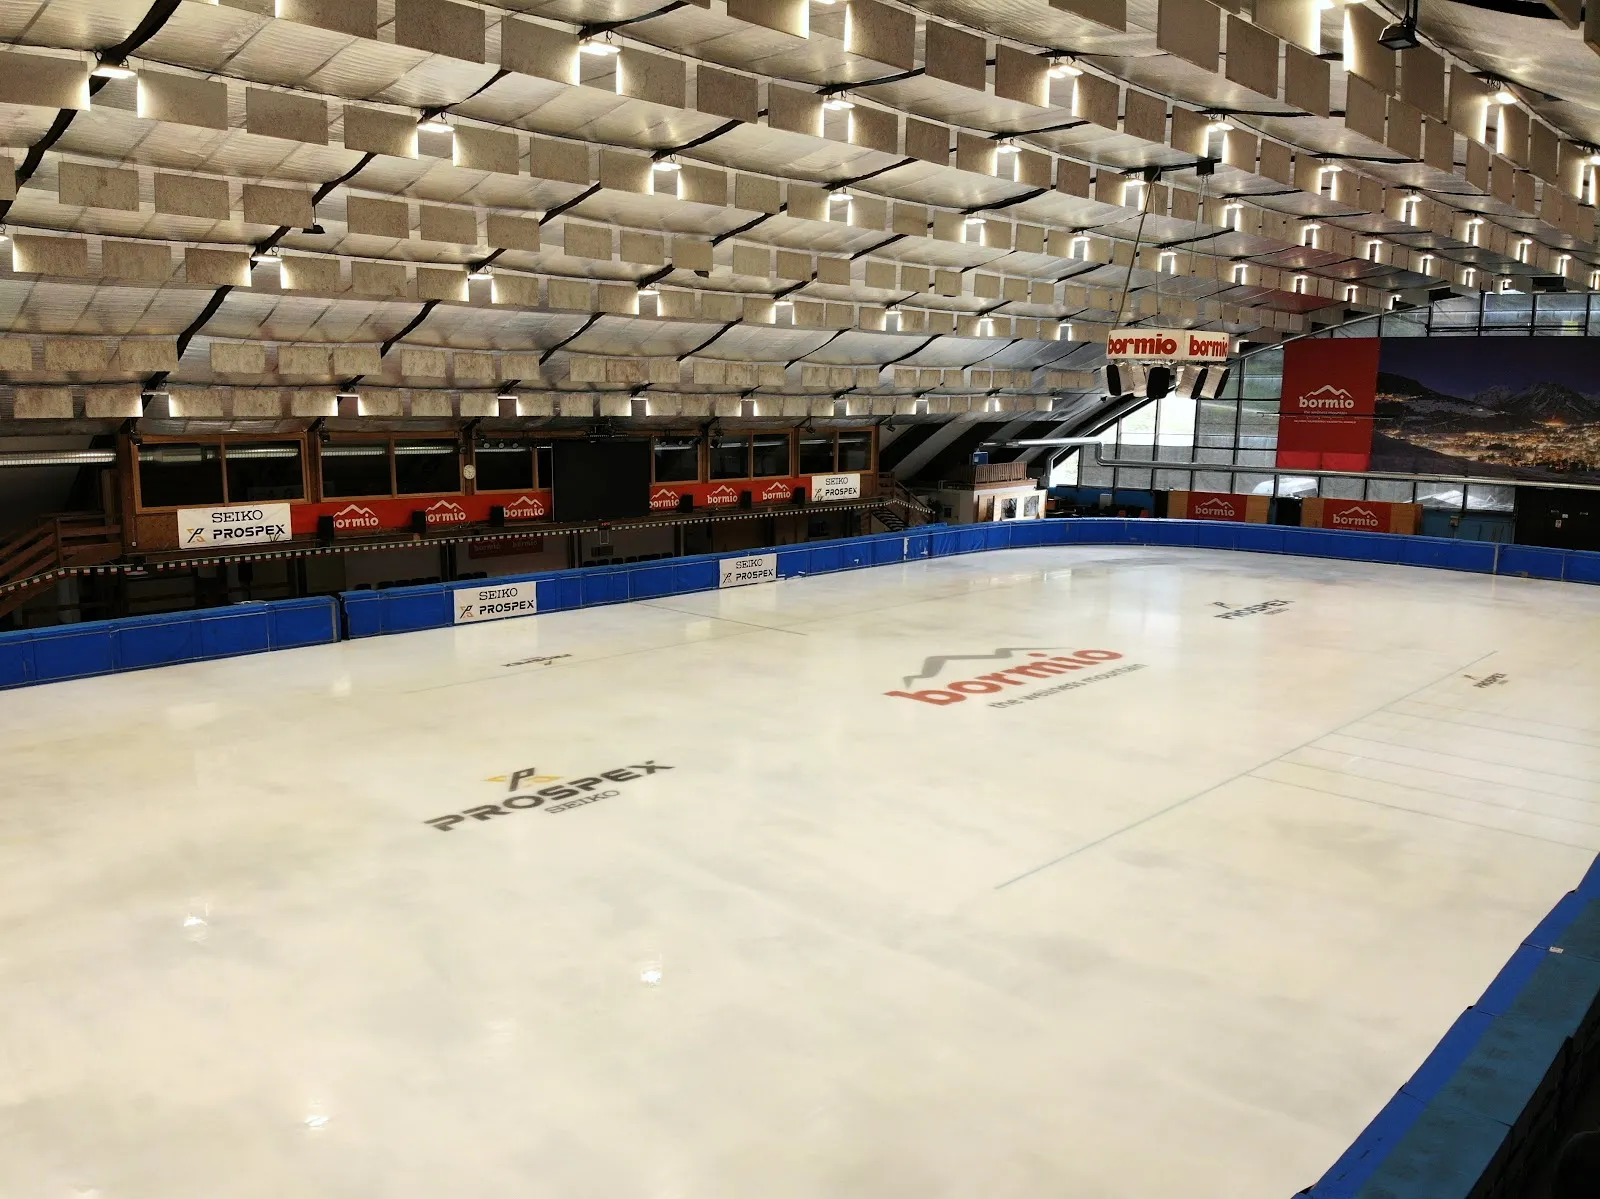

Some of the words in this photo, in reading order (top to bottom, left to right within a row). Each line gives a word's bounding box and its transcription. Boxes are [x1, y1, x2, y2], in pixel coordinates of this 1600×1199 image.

[1108, 334, 1177, 355] bormio
[1299, 395, 1354, 408] bormio
[825, 477, 848, 485] SEIKO
[707, 493, 738, 504] bormio
[762, 490, 791, 500] bormio
[825, 487, 858, 496] PROSPEX
[211, 509, 263, 524] SEIKO
[425, 508, 467, 522] ormio
[503, 504, 544, 518] bormio
[1195, 505, 1235, 517] bormio
[333, 513, 379, 528] ormio
[1332, 513, 1379, 527] bormio
[213, 524, 285, 540] PROSPEX
[735, 558, 763, 569] SEIKO
[735, 568, 774, 581] PROSPEX
[479, 587, 518, 601] SEIKO
[479, 599, 534, 615] PROSPEX
[883, 649, 1123, 706] bormio
[988, 699, 1022, 709] the
[423, 760, 676, 832] PROSPEX
[544, 790, 620, 814] SEIKO
